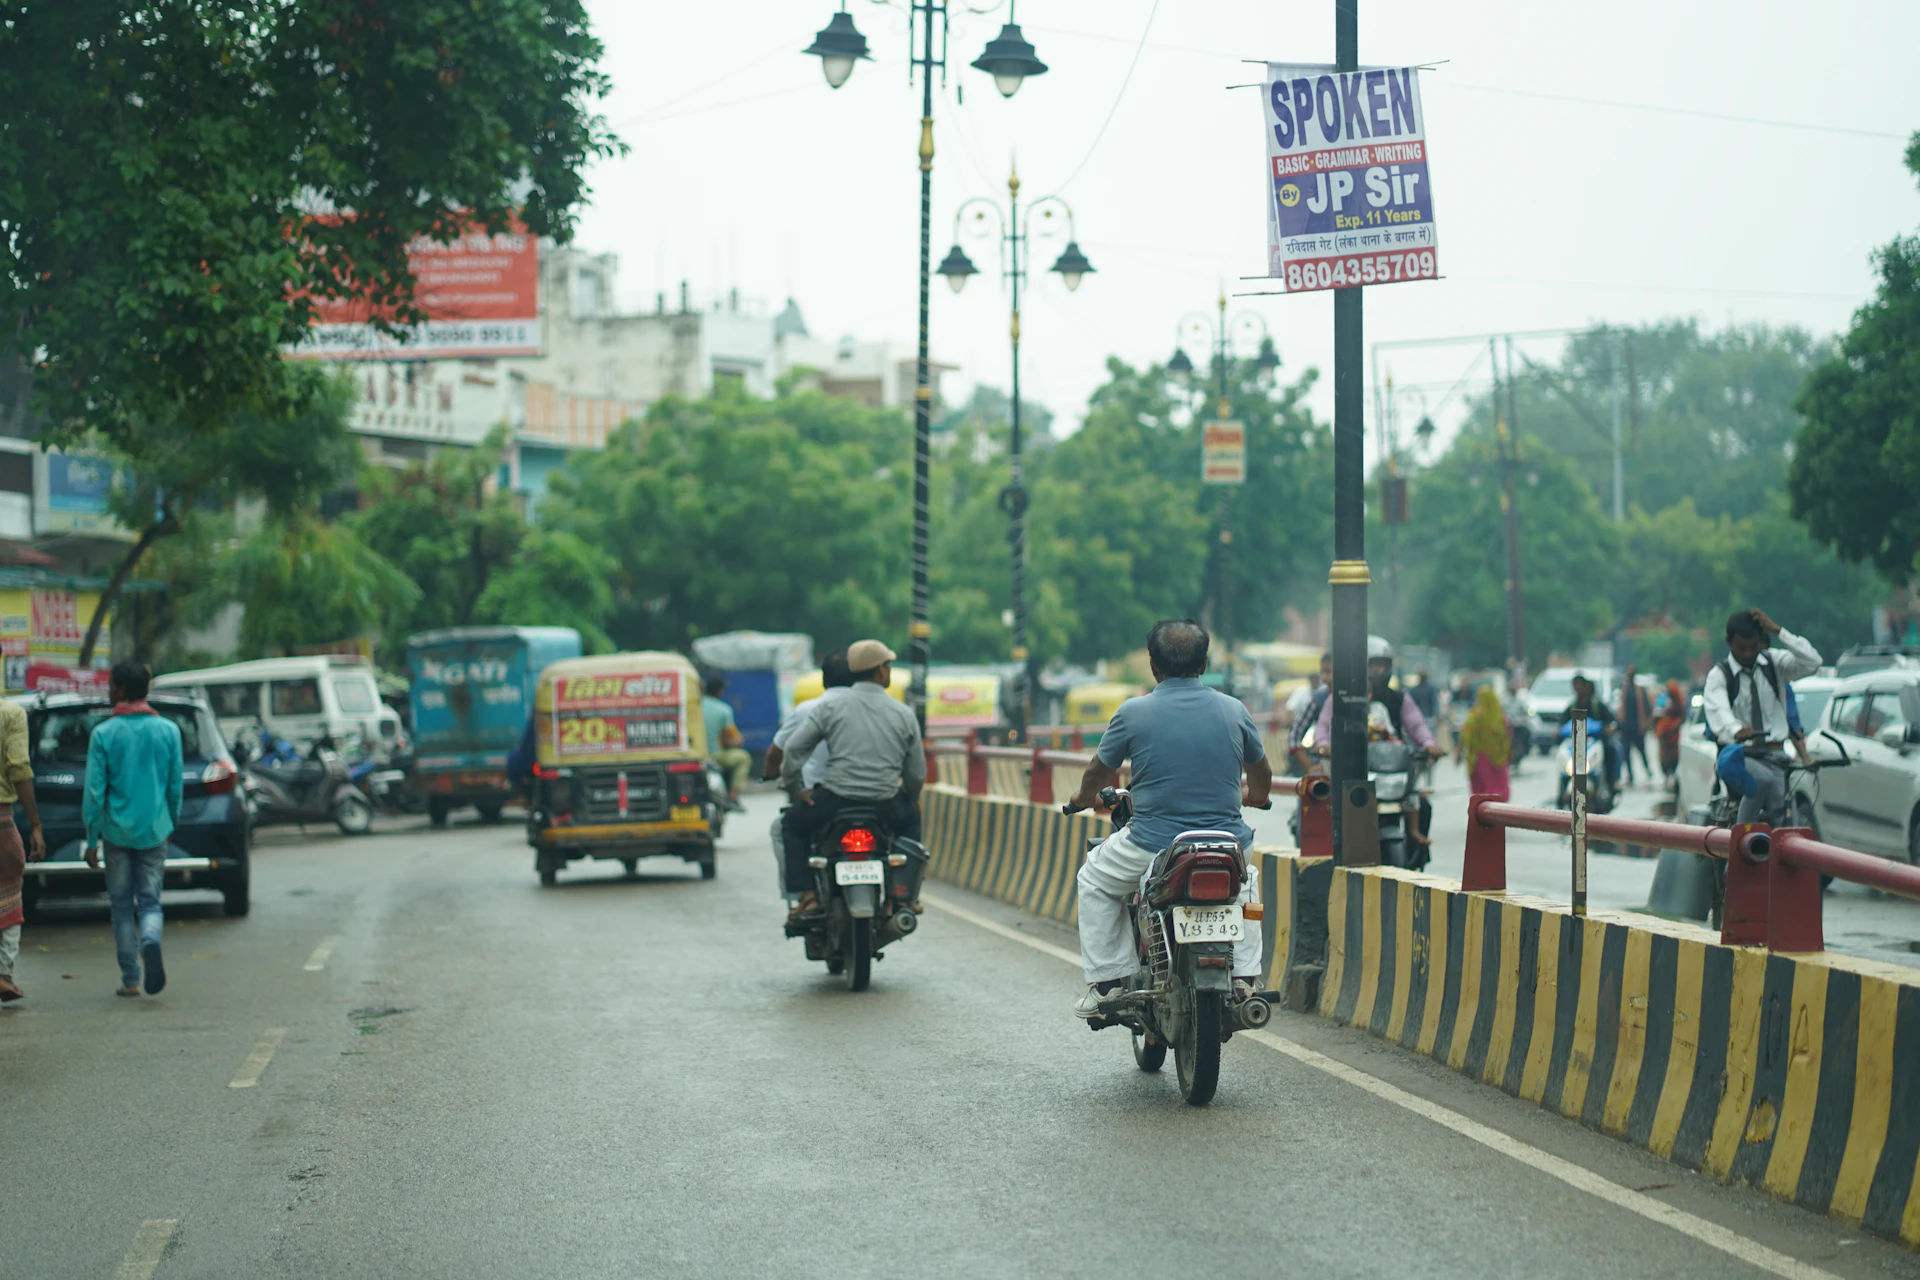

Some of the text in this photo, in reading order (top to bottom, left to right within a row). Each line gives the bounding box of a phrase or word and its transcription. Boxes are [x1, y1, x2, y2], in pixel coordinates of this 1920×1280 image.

[1271, 67, 1417, 149] SPOKEN
[1277, 143, 1422, 175] BASIC GRAMMAR WRITING
[1282, 166, 1420, 214] By JP Sir
[1336, 209, 1421, 230] Exp. 11 Years
[1285, 238, 1316, 254] रविदास
[1319, 236, 1332, 251] गेट
[1383, 230, 1392, 244] के
[1287, 251, 1435, 290] 8604355709
[561, 718, 623, 745] 20%
